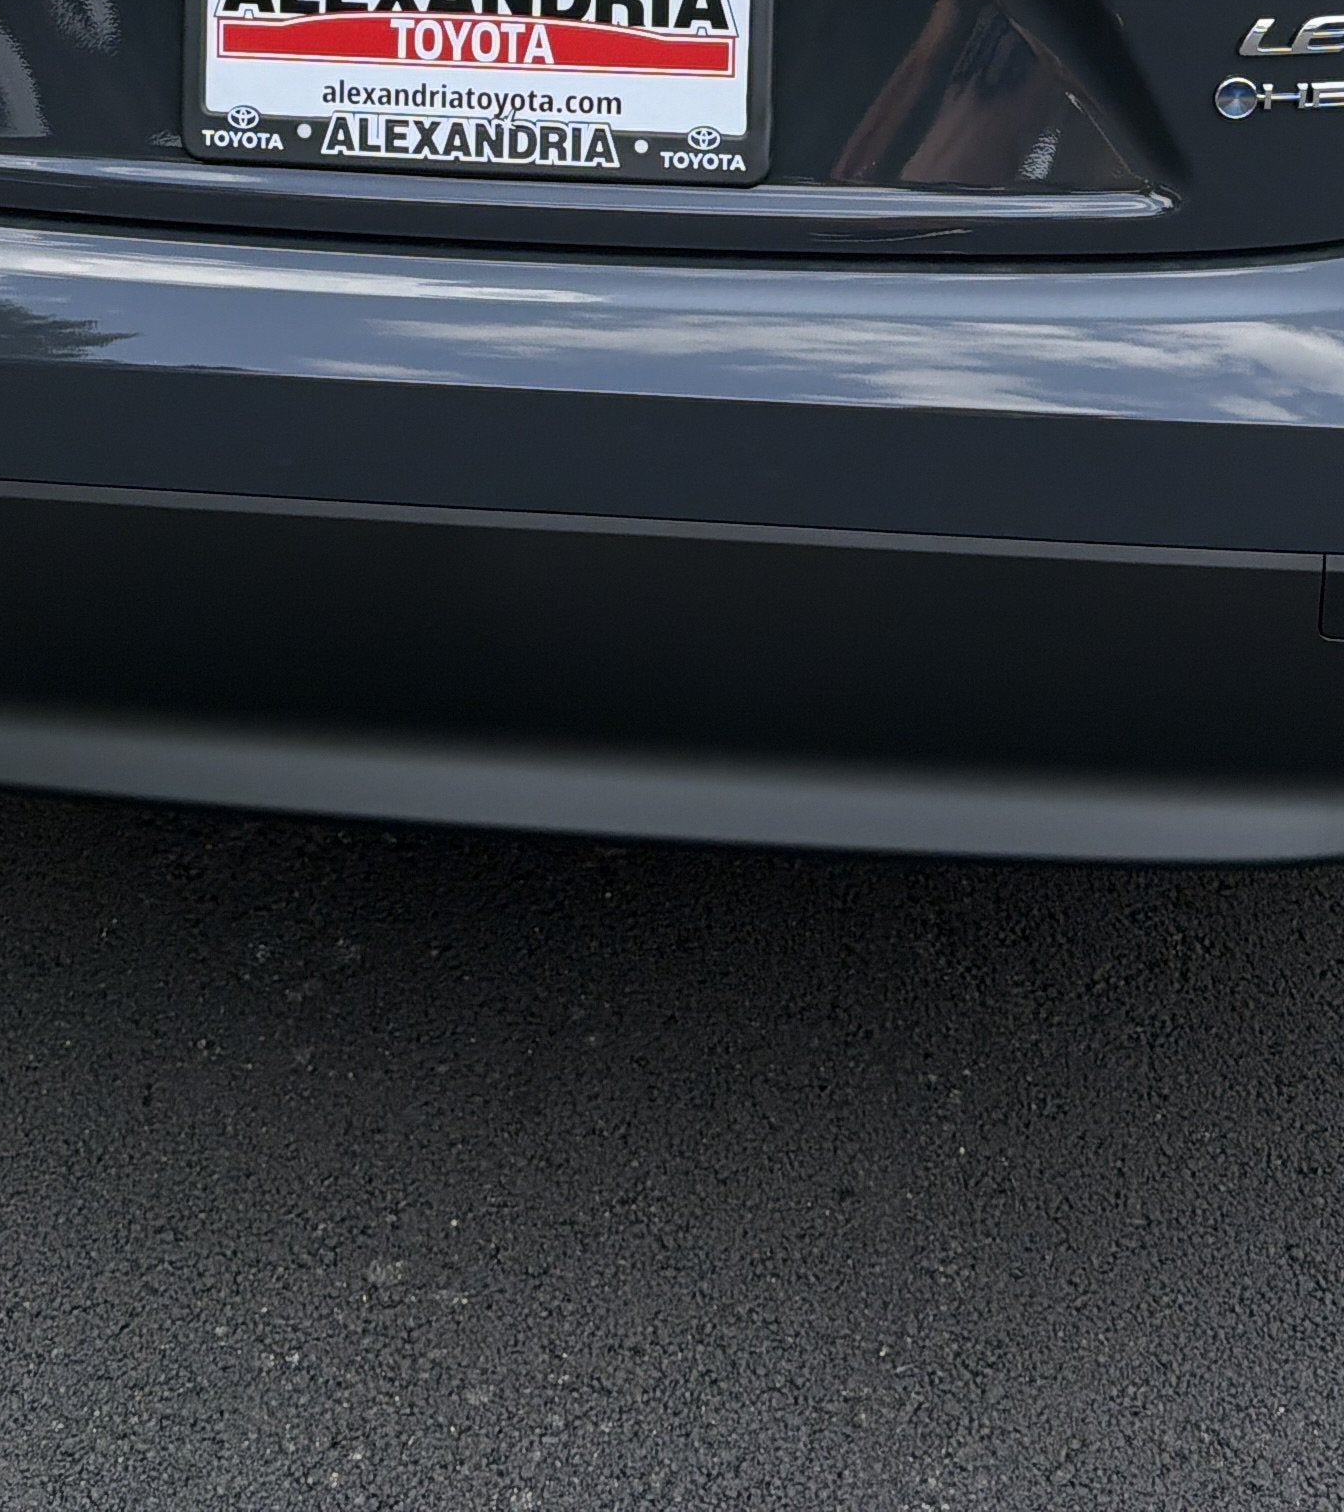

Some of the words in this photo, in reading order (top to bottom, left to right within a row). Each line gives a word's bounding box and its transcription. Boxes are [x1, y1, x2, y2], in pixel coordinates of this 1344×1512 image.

[390, 18, 556, 65] TOYOTA
[321, 81, 622, 116] alexandriatoyota.com
[202, 130, 283, 151] TOYOTA
[322, 117, 618, 168] ALEXANDRIA
[661, 151, 745, 172] TOYOTA
